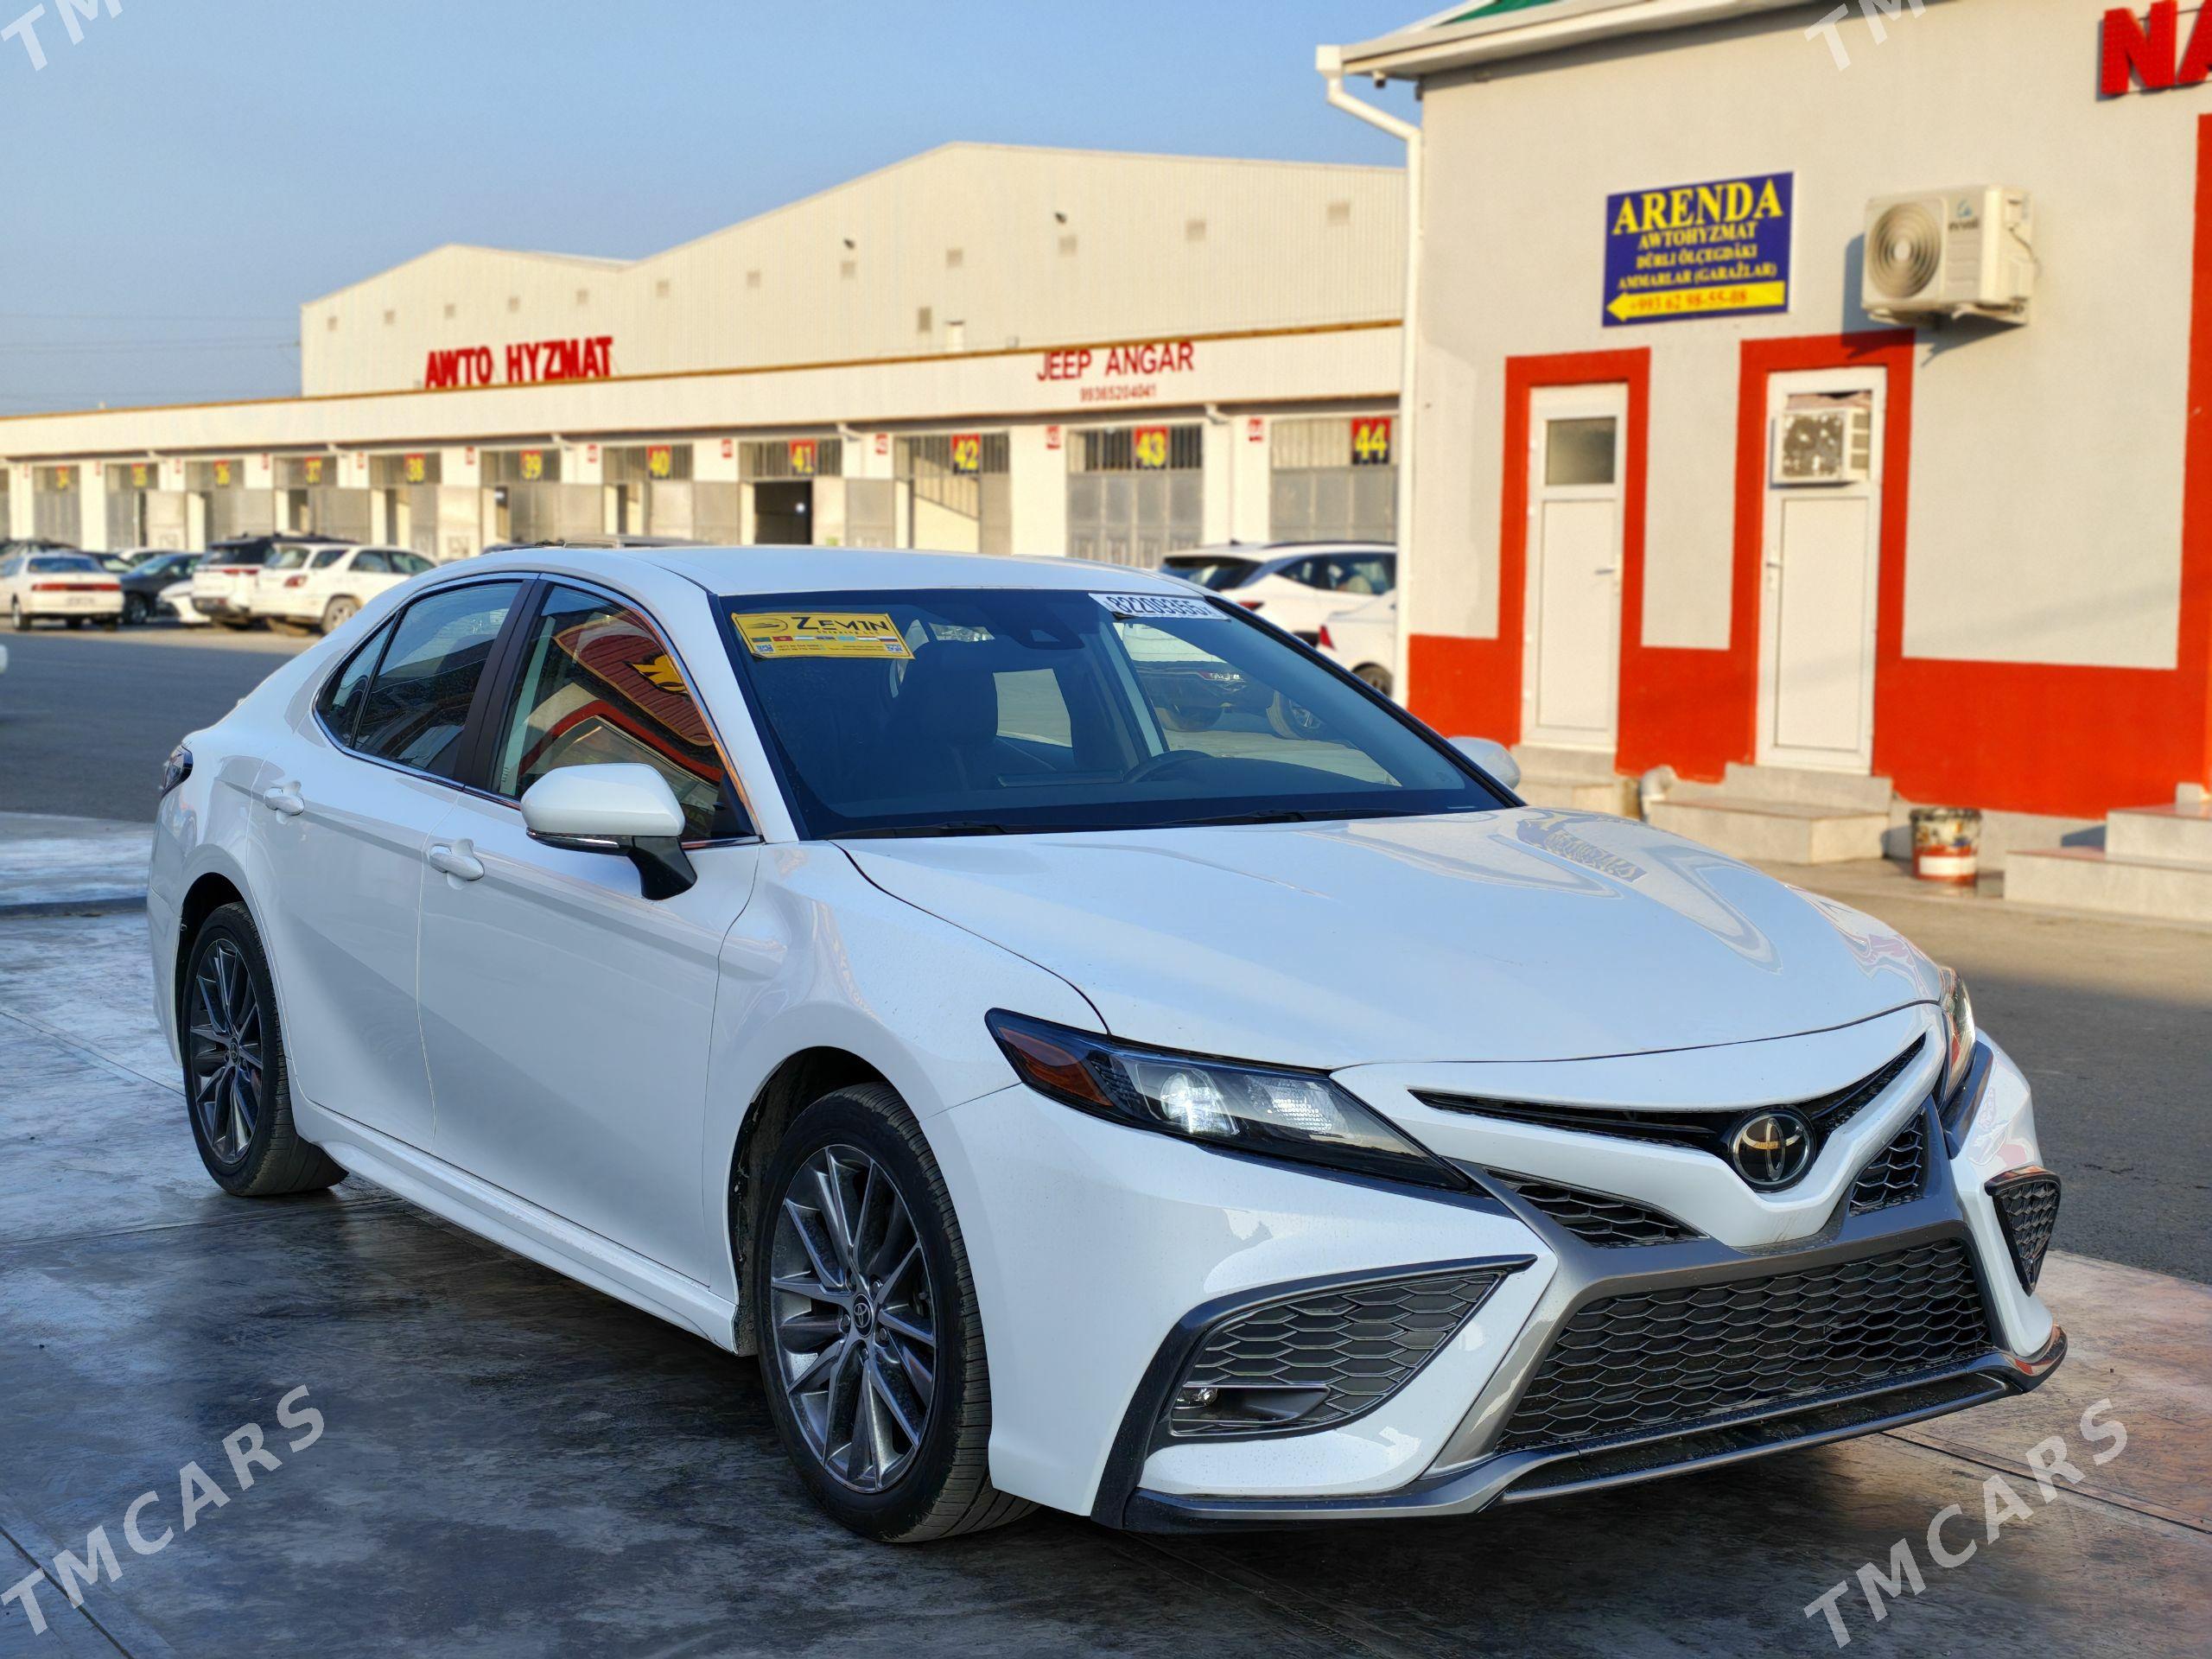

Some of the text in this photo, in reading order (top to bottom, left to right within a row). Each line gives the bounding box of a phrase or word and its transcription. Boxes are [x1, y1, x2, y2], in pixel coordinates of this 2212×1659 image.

[1611, 178, 1784, 234] ARENDA
[1637, 220, 1758, 251] AWTOHYZMAT
[424, 335, 613, 389] AWTO HYZMAT
[1036, 340, 1195, 381] JEEP ANGAR
[952, 439, 980, 471] 42
[1135, 430, 1166, 467] 43
[1354, 423, 1389, 461] 44
